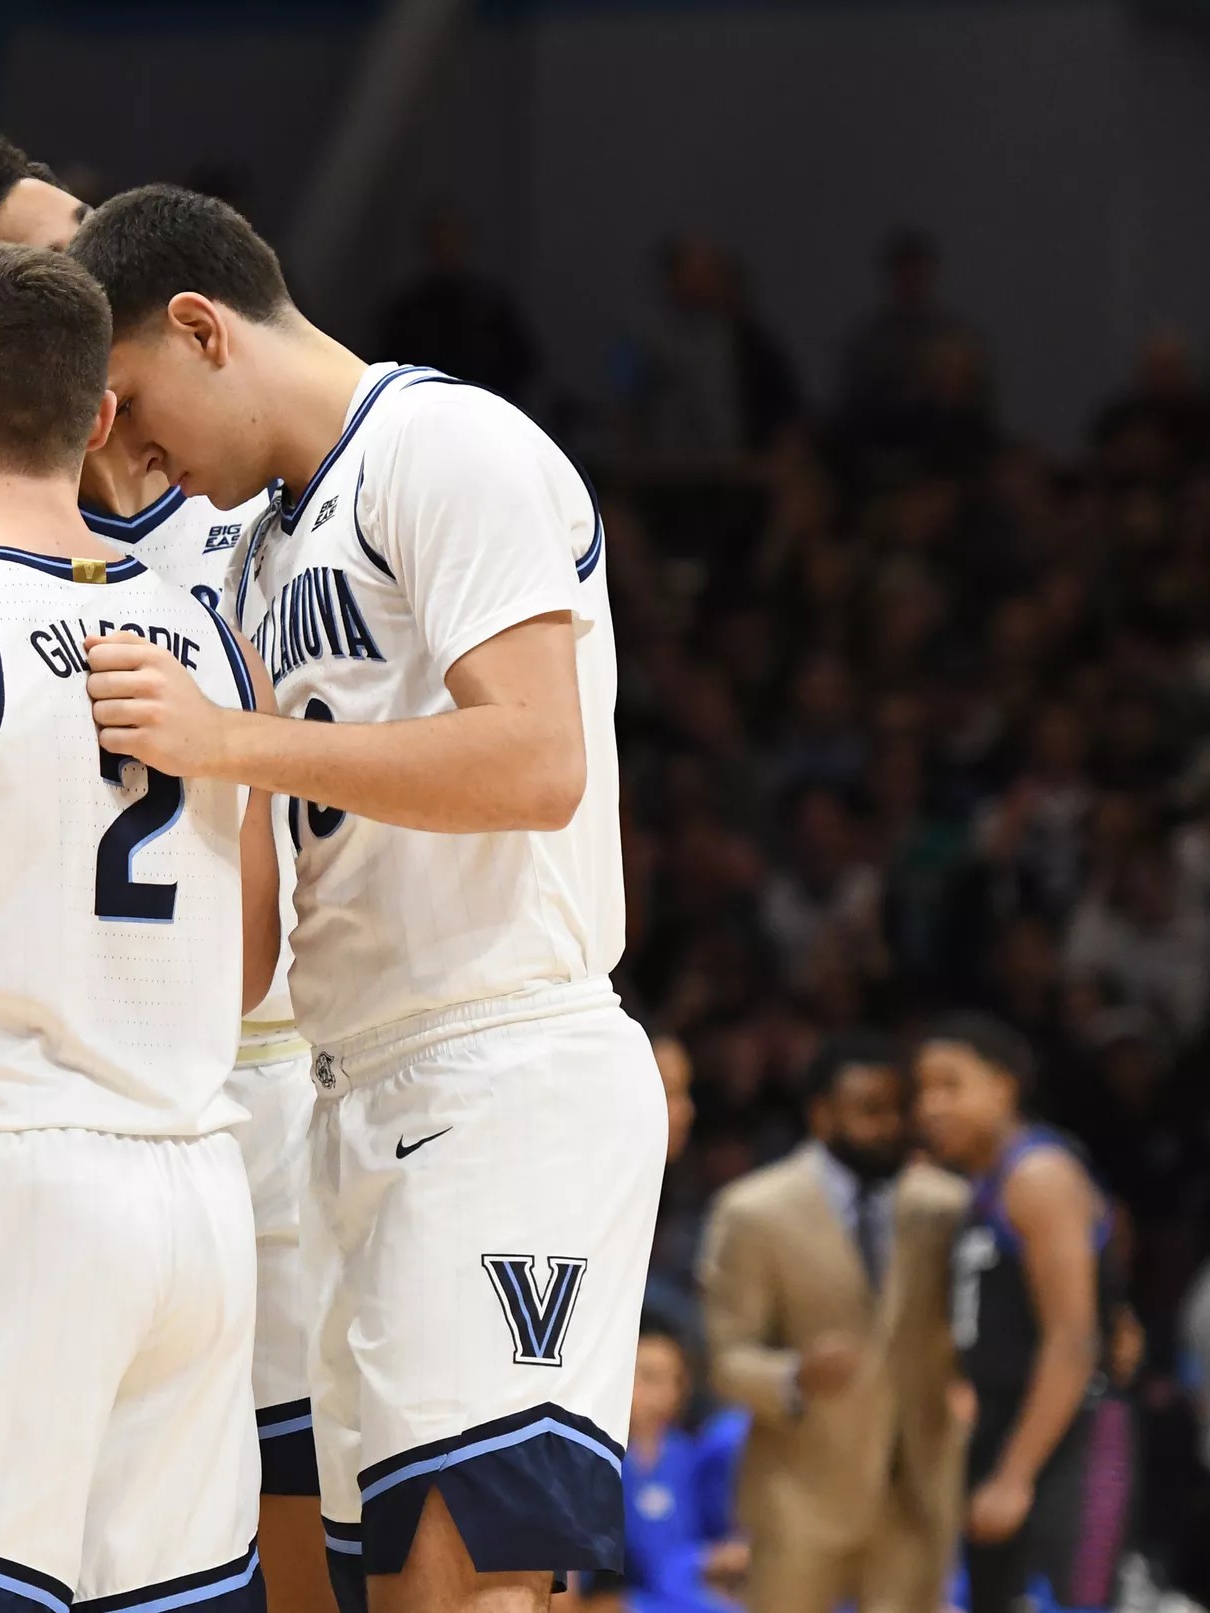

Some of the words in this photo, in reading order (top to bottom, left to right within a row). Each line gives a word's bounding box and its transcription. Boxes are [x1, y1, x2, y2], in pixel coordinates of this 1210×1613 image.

[205, 534, 241, 548] EAS
[209, 523, 243, 536] BIG
[250, 566, 388, 686] LANOVA
[95, 746, 186, 924] 2
[480, 1253, 588, 1367] V
